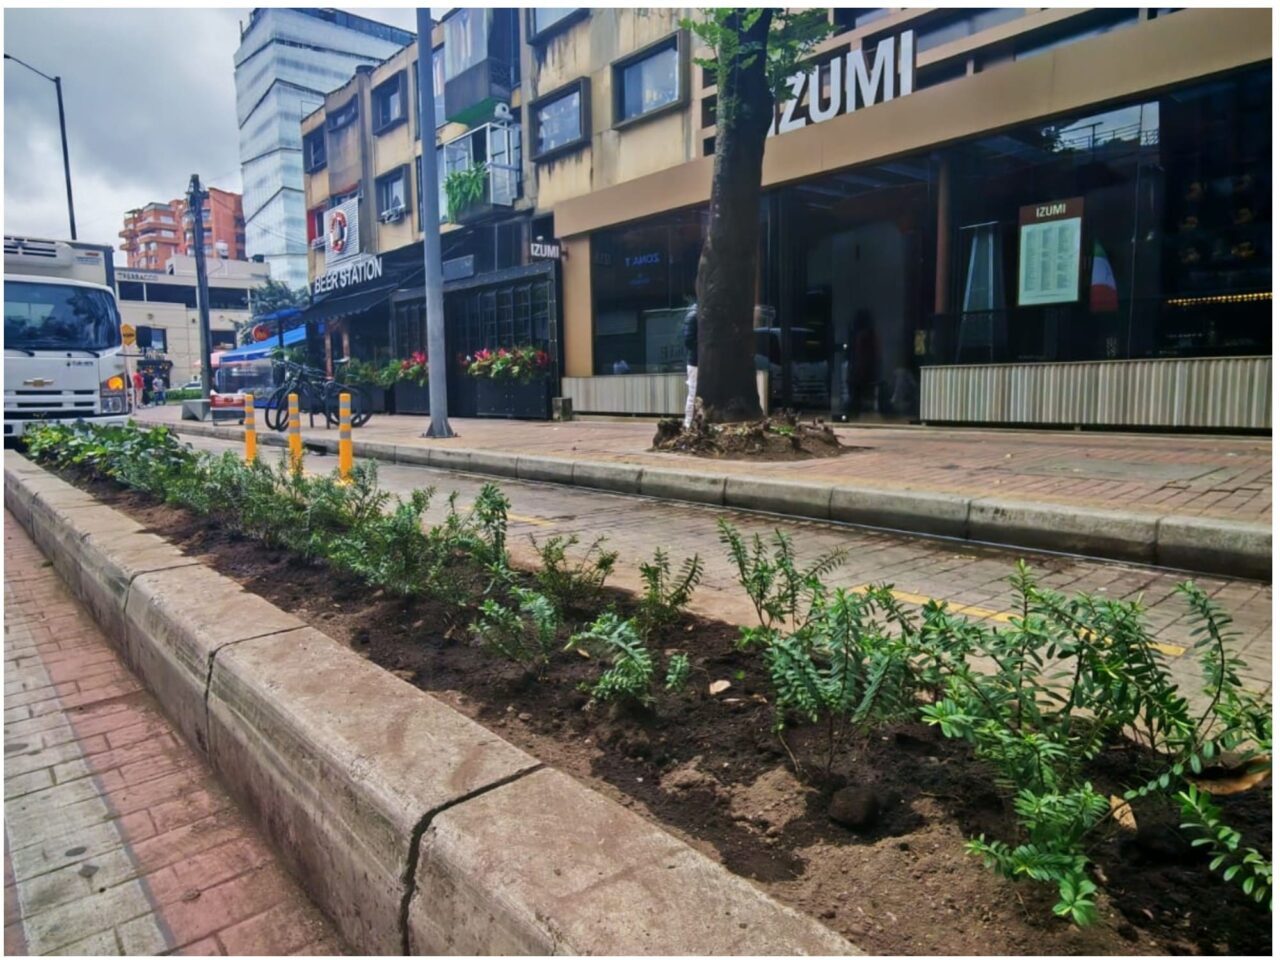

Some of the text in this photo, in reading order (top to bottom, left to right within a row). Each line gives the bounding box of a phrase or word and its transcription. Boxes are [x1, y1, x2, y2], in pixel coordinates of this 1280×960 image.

[1035, 203, 1066, 218] IZUMI
[530, 243, 560, 259] IZUMI
[314, 257, 382, 295] BEER STATION
